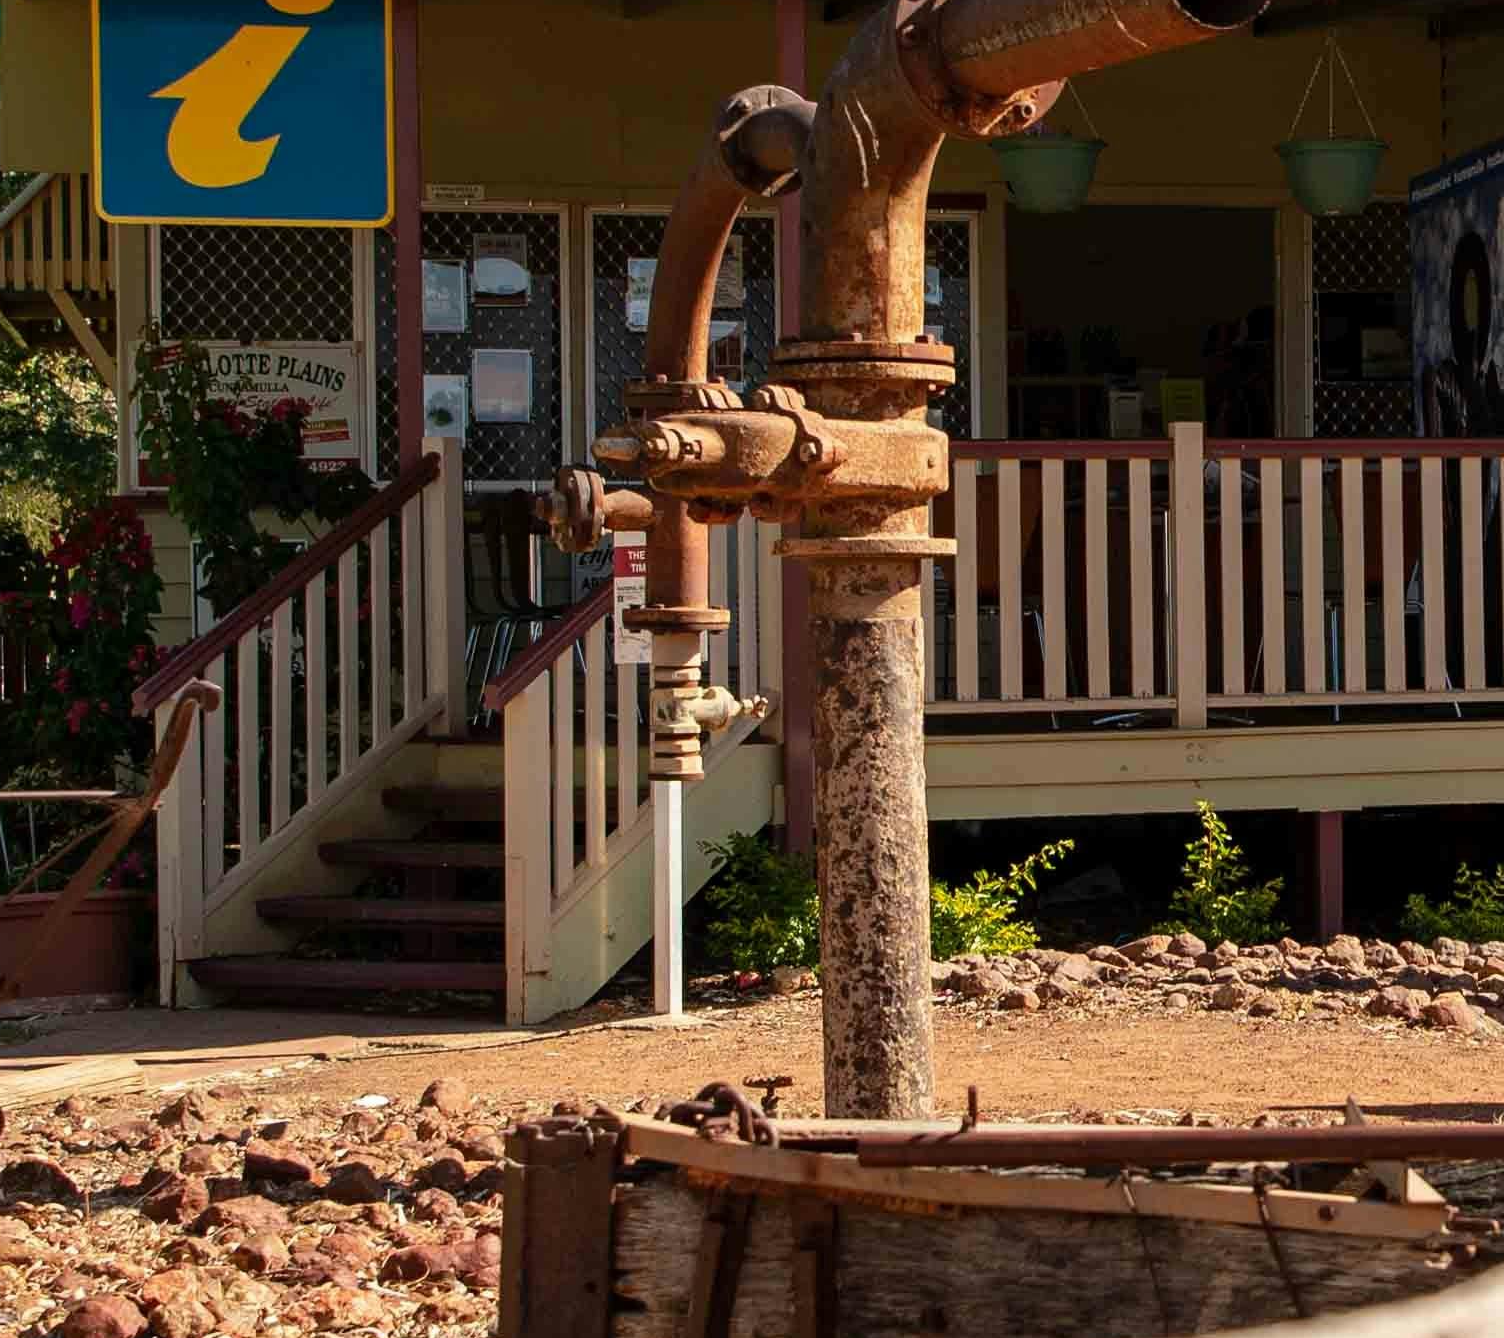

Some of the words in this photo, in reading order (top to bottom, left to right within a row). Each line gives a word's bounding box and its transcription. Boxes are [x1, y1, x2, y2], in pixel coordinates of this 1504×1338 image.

[276, 356, 345, 392] PLAINS
[627, 549, 646, 560] THE
[630, 562, 647, 573] TIM
